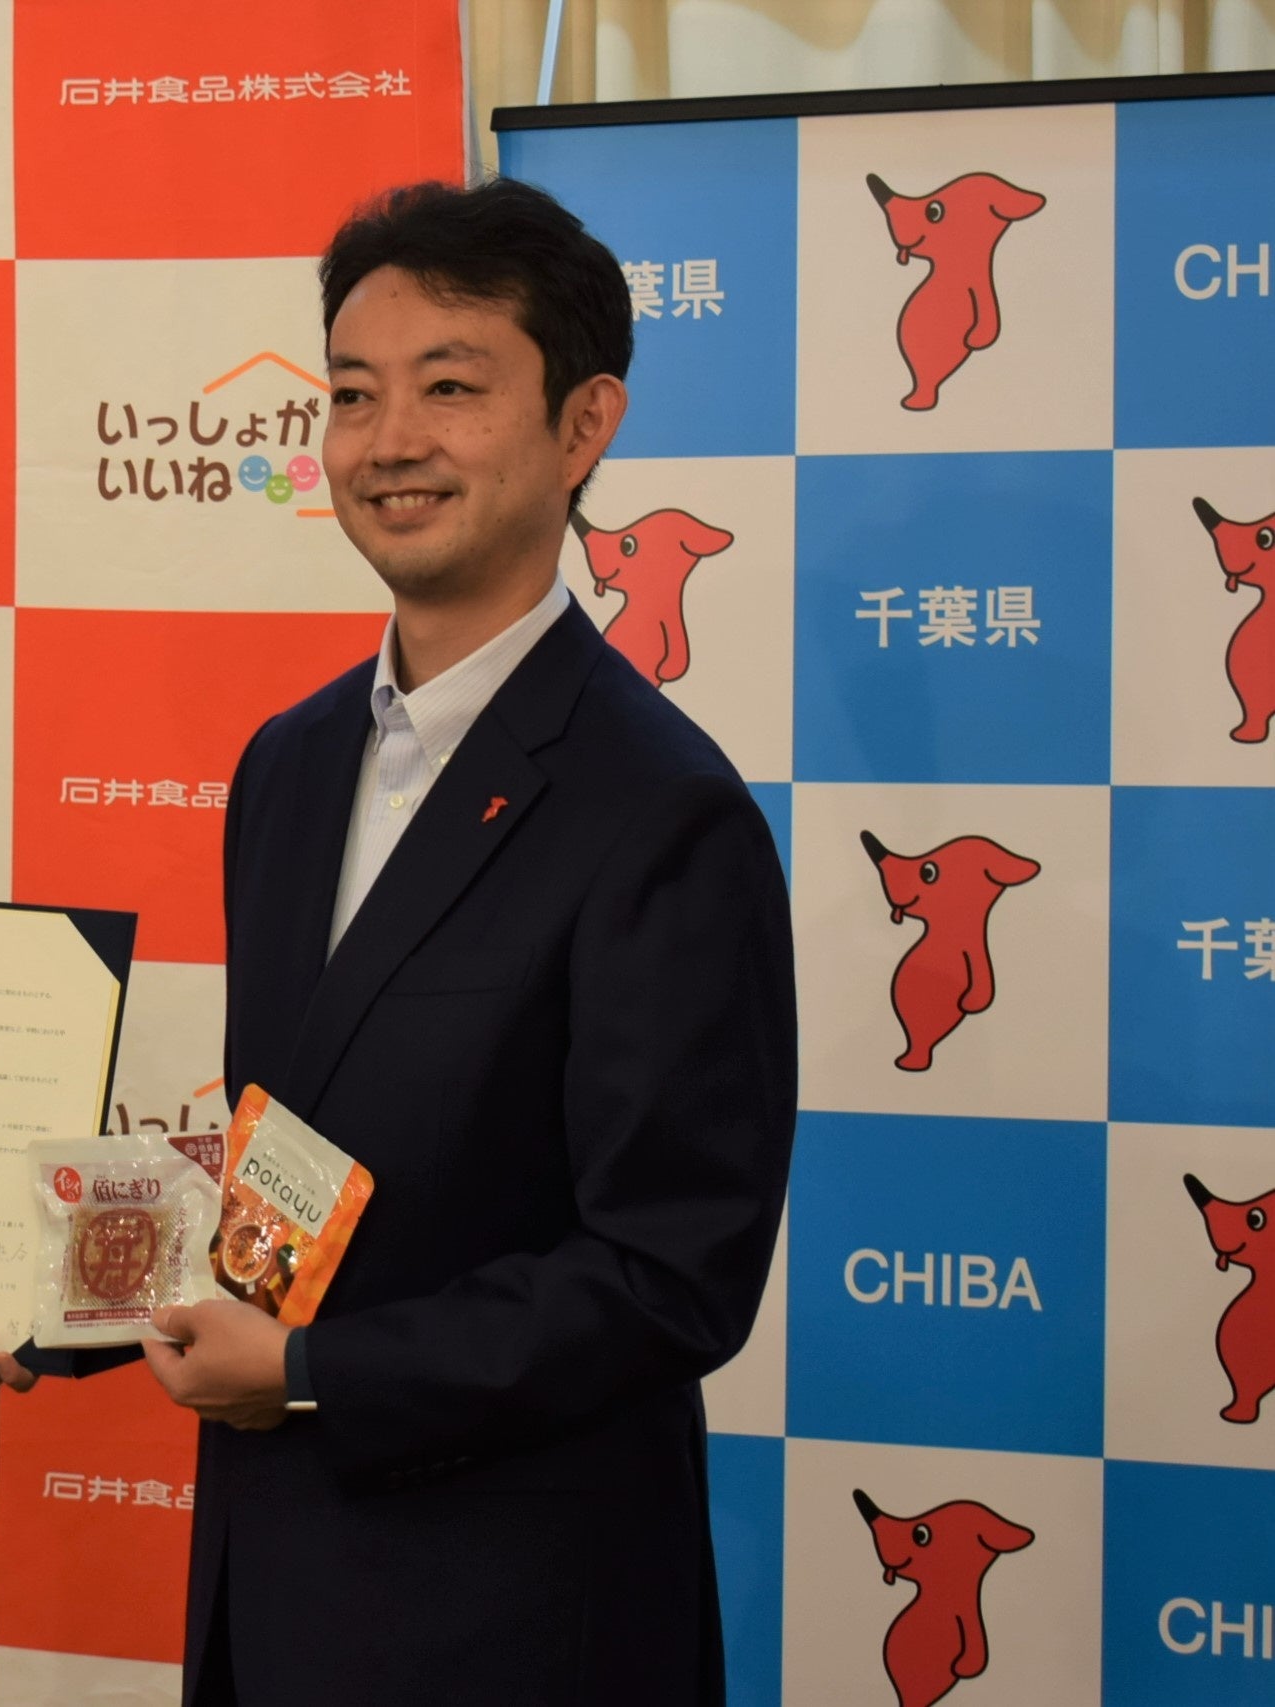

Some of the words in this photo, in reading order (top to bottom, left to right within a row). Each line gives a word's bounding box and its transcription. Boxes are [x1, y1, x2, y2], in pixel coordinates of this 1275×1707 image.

[59, 69, 412, 107] 石井食品株式会社
[1174, 243, 1269, 300] CH
[97, 397, 321, 447] いっしょが
[97, 456, 233, 503] いいね
[854, 586, 1041, 649] 千葉県
[60, 777, 228, 808] 石井食品
[242, 1155, 323, 1225] potayu
[844, 1247, 1043, 1312] CHIBA
[1158, 1596, 1273, 1660] CHI
